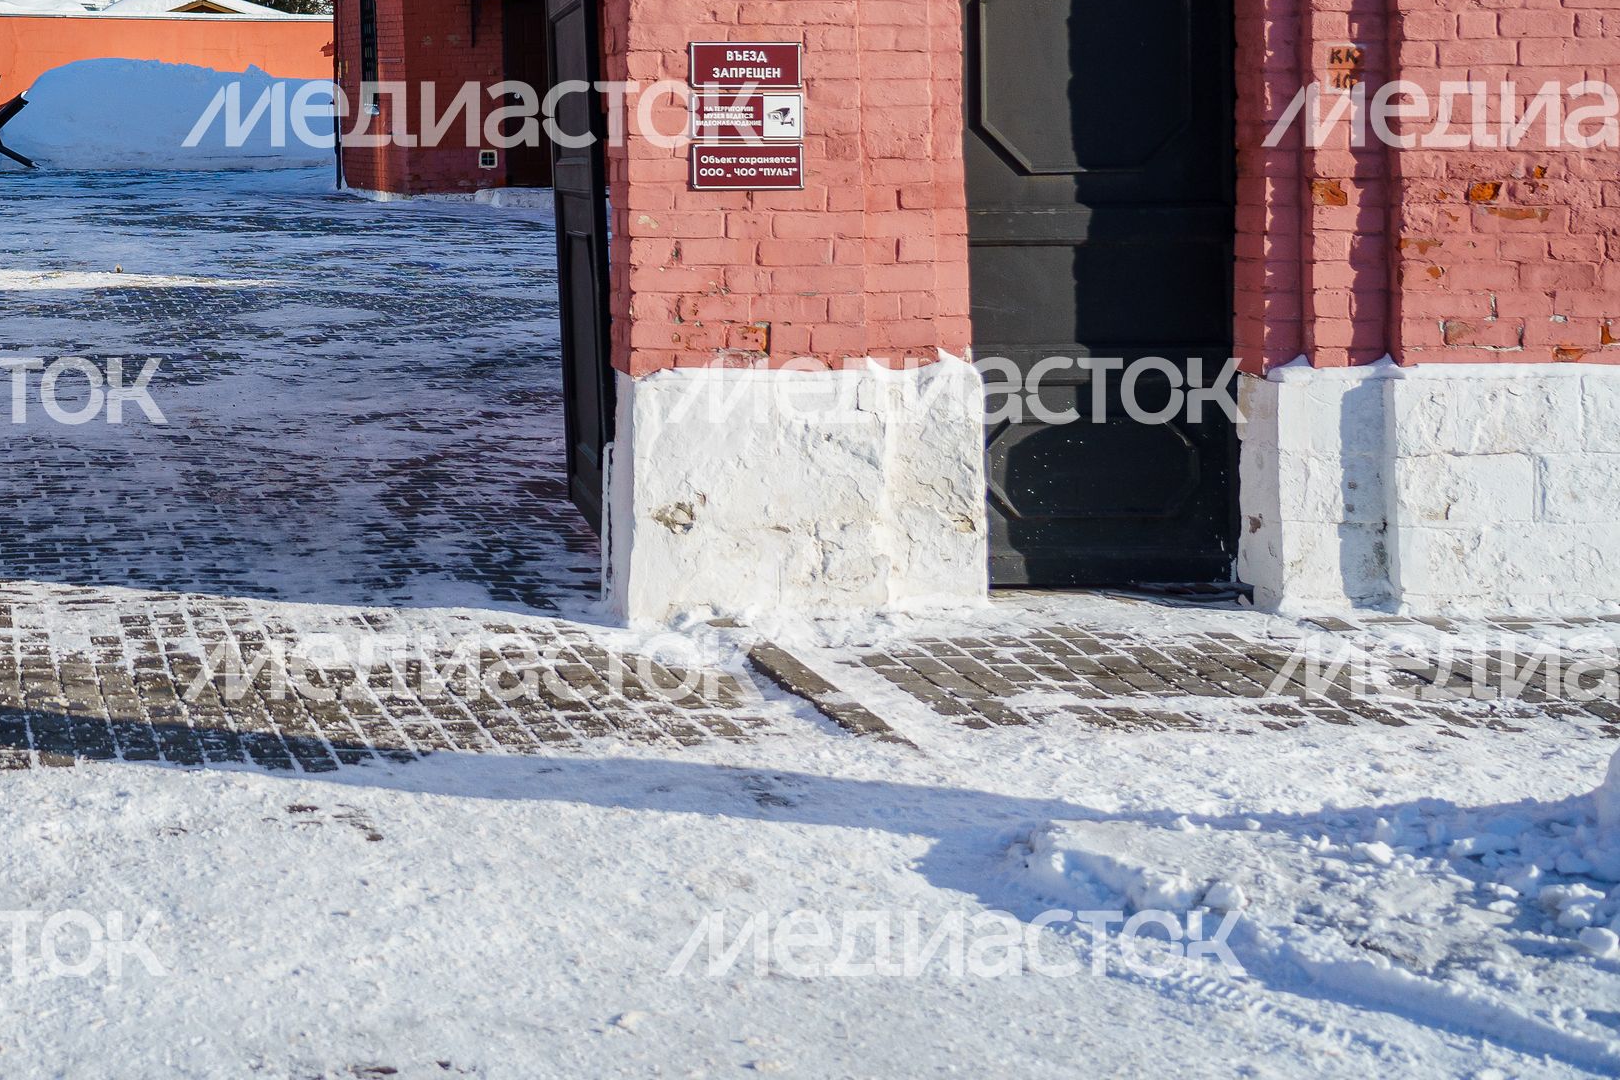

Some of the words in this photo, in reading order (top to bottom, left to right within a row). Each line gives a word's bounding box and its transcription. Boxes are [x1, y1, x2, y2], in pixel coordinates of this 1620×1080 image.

[726, 50, 767, 63] ВЪЕЗД
[712, 67, 781, 79] ЗАПРЕЩЕН
[701, 155, 737, 164] Объект
[739, 156, 796, 165] охраняется
[700, 169, 724, 177] ООО
[734, 169, 756, 177] ЧОО
[759, 168, 798, 177] "ПУЛЬТ"
